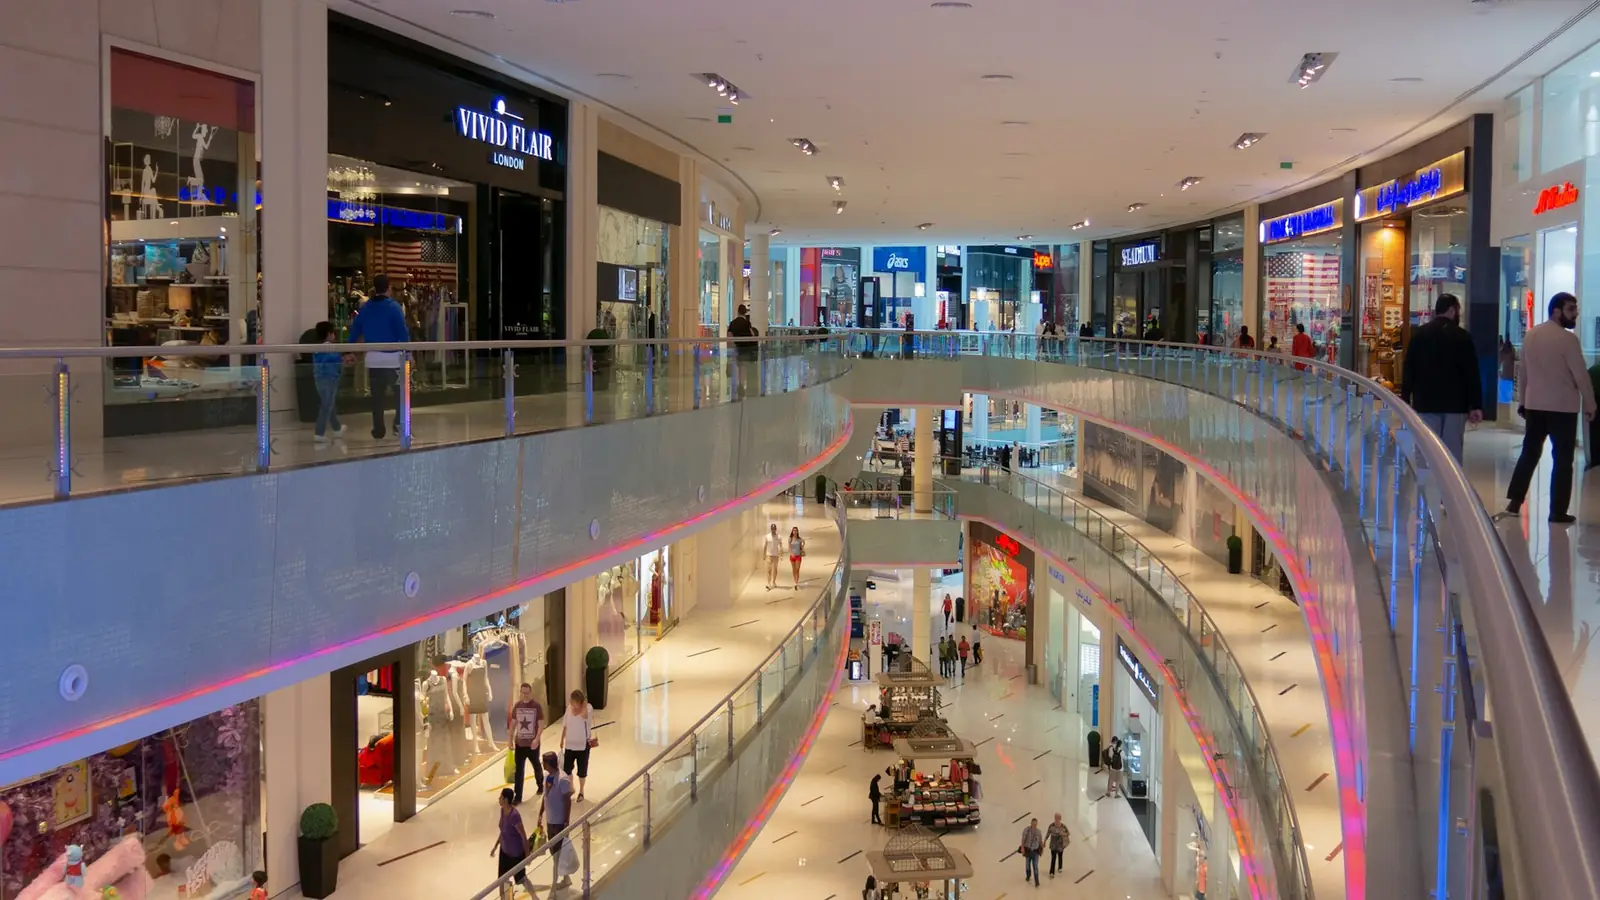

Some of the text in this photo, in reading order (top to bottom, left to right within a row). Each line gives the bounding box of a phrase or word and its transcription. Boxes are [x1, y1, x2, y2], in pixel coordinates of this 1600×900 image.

[459, 107, 552, 160] VIVID FLAIR
[493, 152, 524, 170] LONDON
